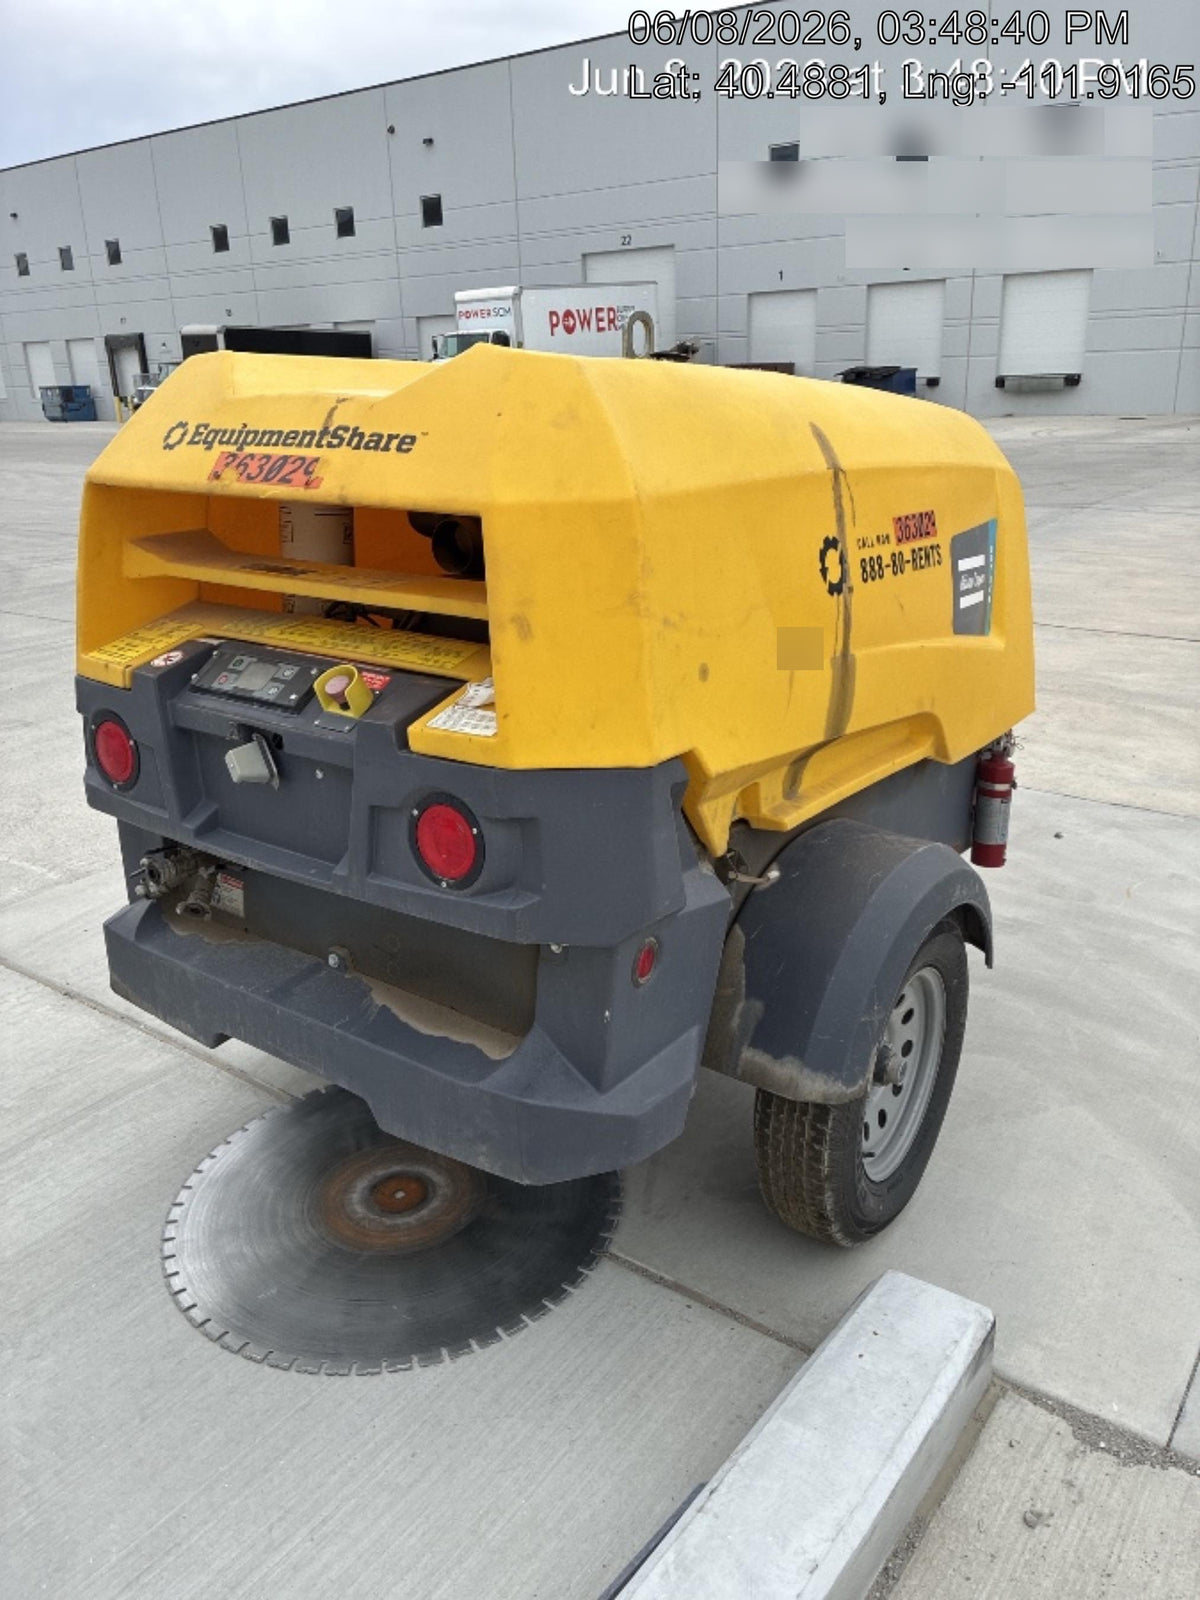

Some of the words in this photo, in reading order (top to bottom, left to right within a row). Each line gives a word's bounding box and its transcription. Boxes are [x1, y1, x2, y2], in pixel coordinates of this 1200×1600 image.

[549, 306, 619, 336] POWER
[187, 422, 416, 454] EquipmentShare
[860, 544, 943, 583] 888-80-RENTS
